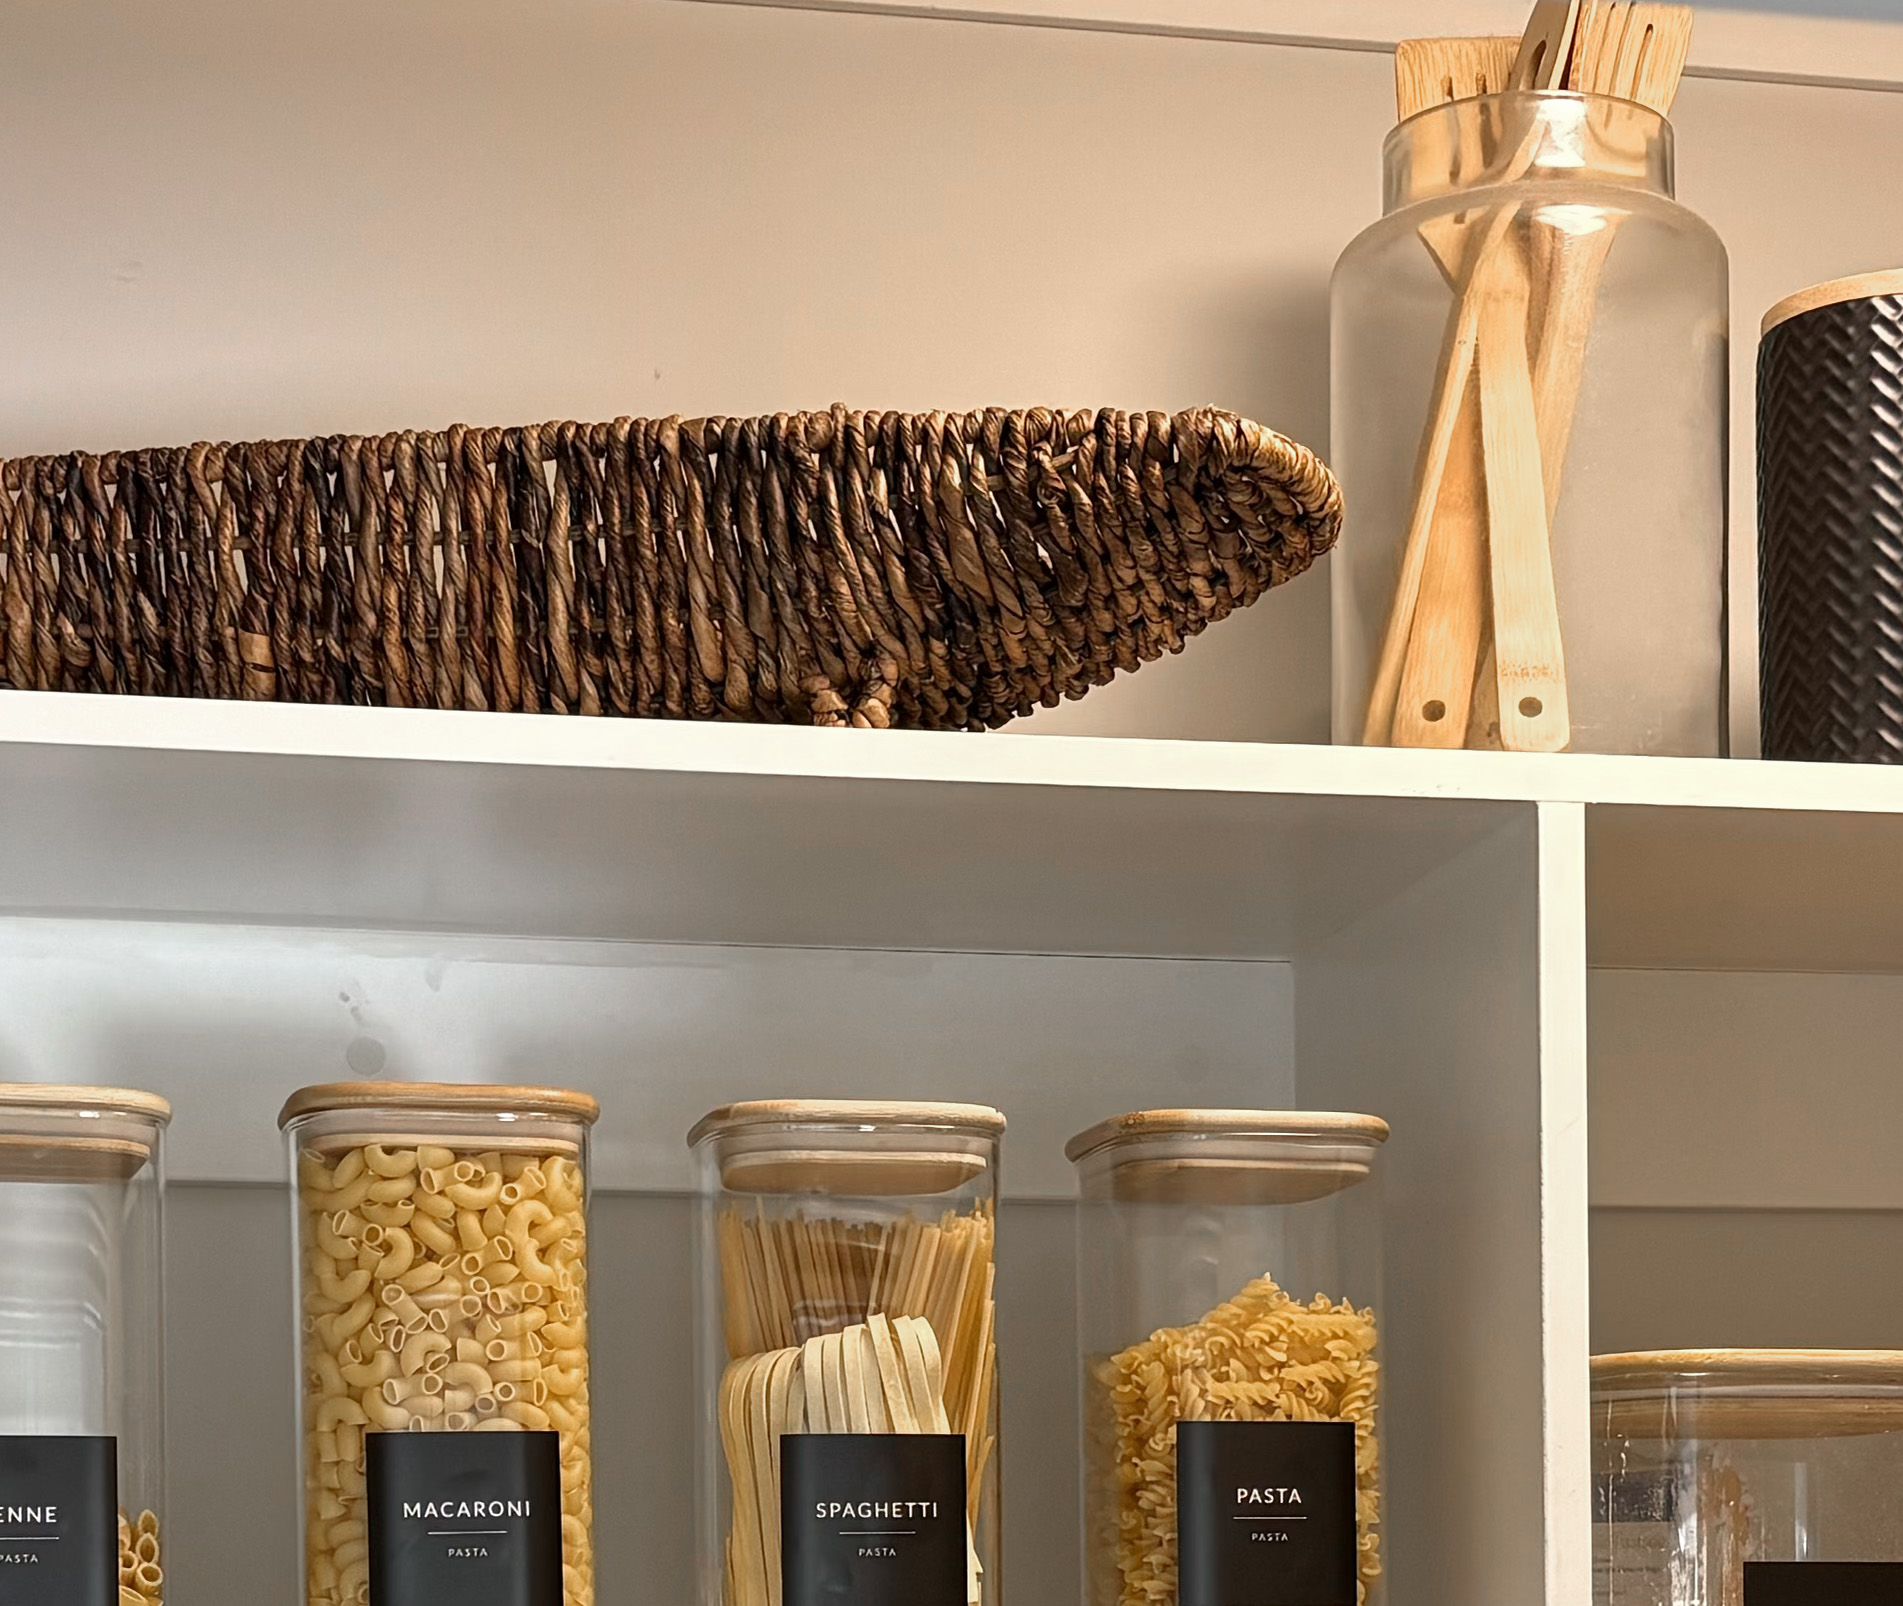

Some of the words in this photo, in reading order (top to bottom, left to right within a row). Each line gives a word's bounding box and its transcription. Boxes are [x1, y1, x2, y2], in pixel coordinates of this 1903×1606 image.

[1236, 1487, 1303, 1506] PASTA
[403, 1500, 531, 1519] MACARONI
[815, 1501, 938, 1520] SPAGHETTI
[1251, 1532, 1289, 1543] PASTA
[448, 1547, 488, 1558] PASTA
[858, 1547, 897, 1558] PASTA
